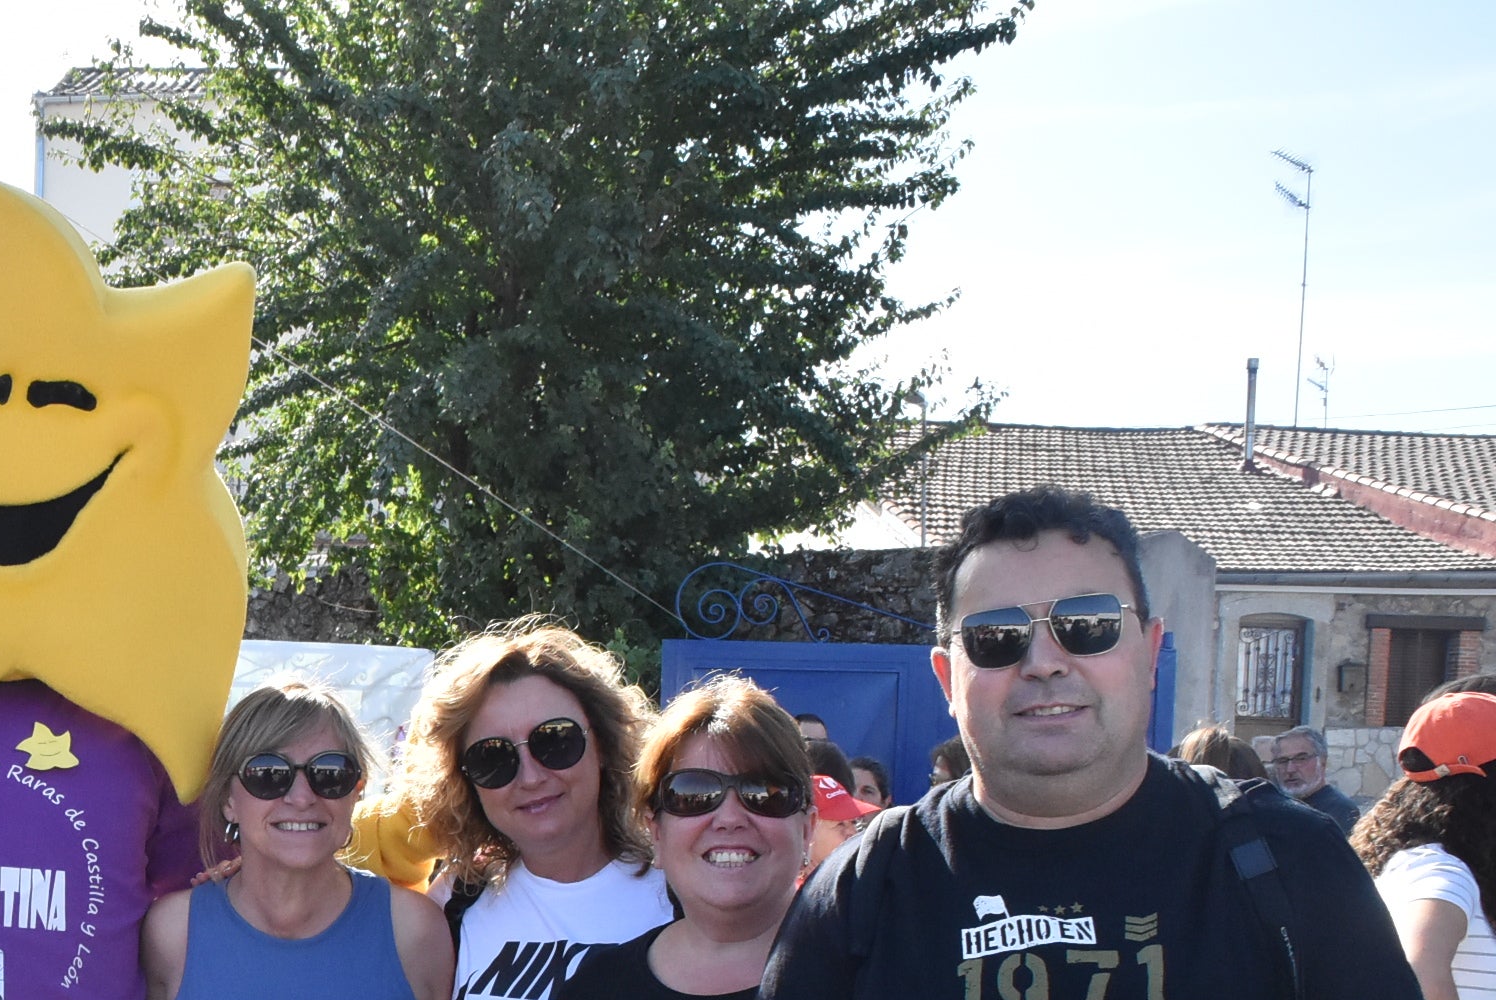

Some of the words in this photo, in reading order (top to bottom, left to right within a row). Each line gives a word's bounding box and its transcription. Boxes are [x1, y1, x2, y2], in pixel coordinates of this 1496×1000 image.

[6, 763, 66, 806] Raras
[64, 807, 86, 831] de
[81, 837, 105, 916] Castilla
[80, 921, 97, 937] y
[965, 918, 1052, 955] HECHO
[1059, 919, 1093, 941] EN
[60, 943, 91, 989] León
